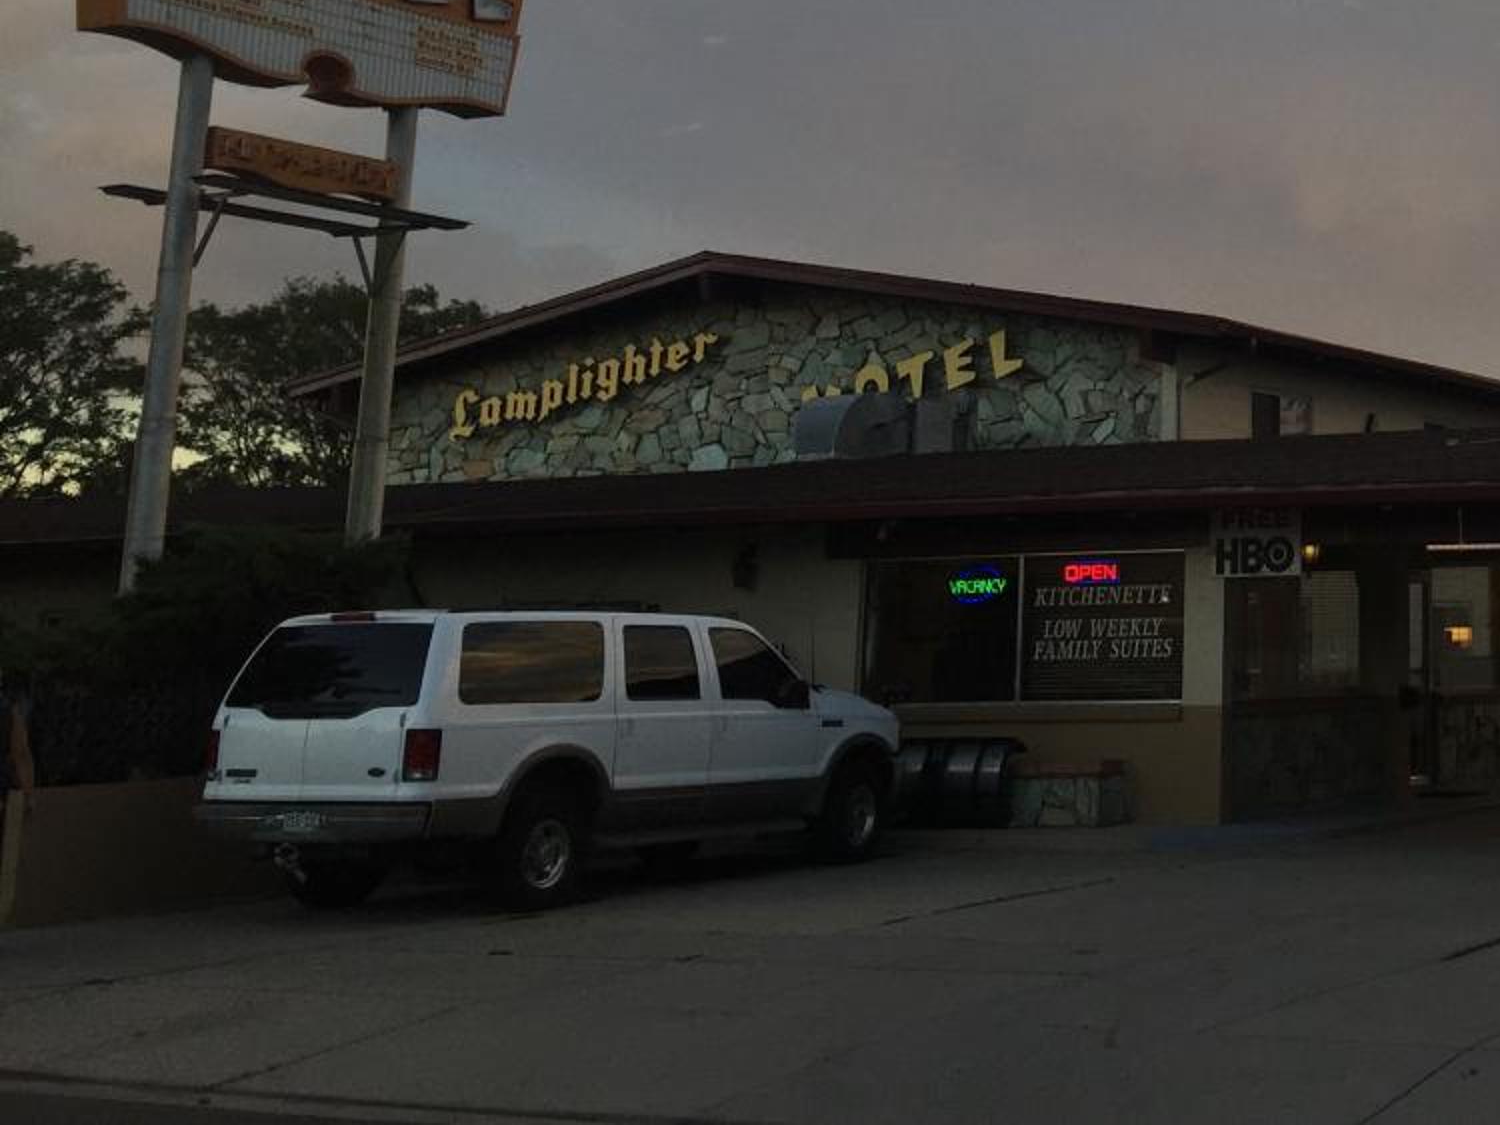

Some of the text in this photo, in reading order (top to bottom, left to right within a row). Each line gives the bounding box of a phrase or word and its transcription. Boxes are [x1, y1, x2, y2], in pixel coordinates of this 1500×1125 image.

[801, 329, 1024, 402] OTEL
[448, 332, 719, 442] Lamplighter
[1216, 538, 1294, 574] HBO
[1063, 562, 1118, 583] OPEN
[948, 577, 1007, 595] VACANCY
[1043, 617, 1165, 638] LOW WEEKLY
[1033, 638, 1174, 660] FAMILY SUITES
